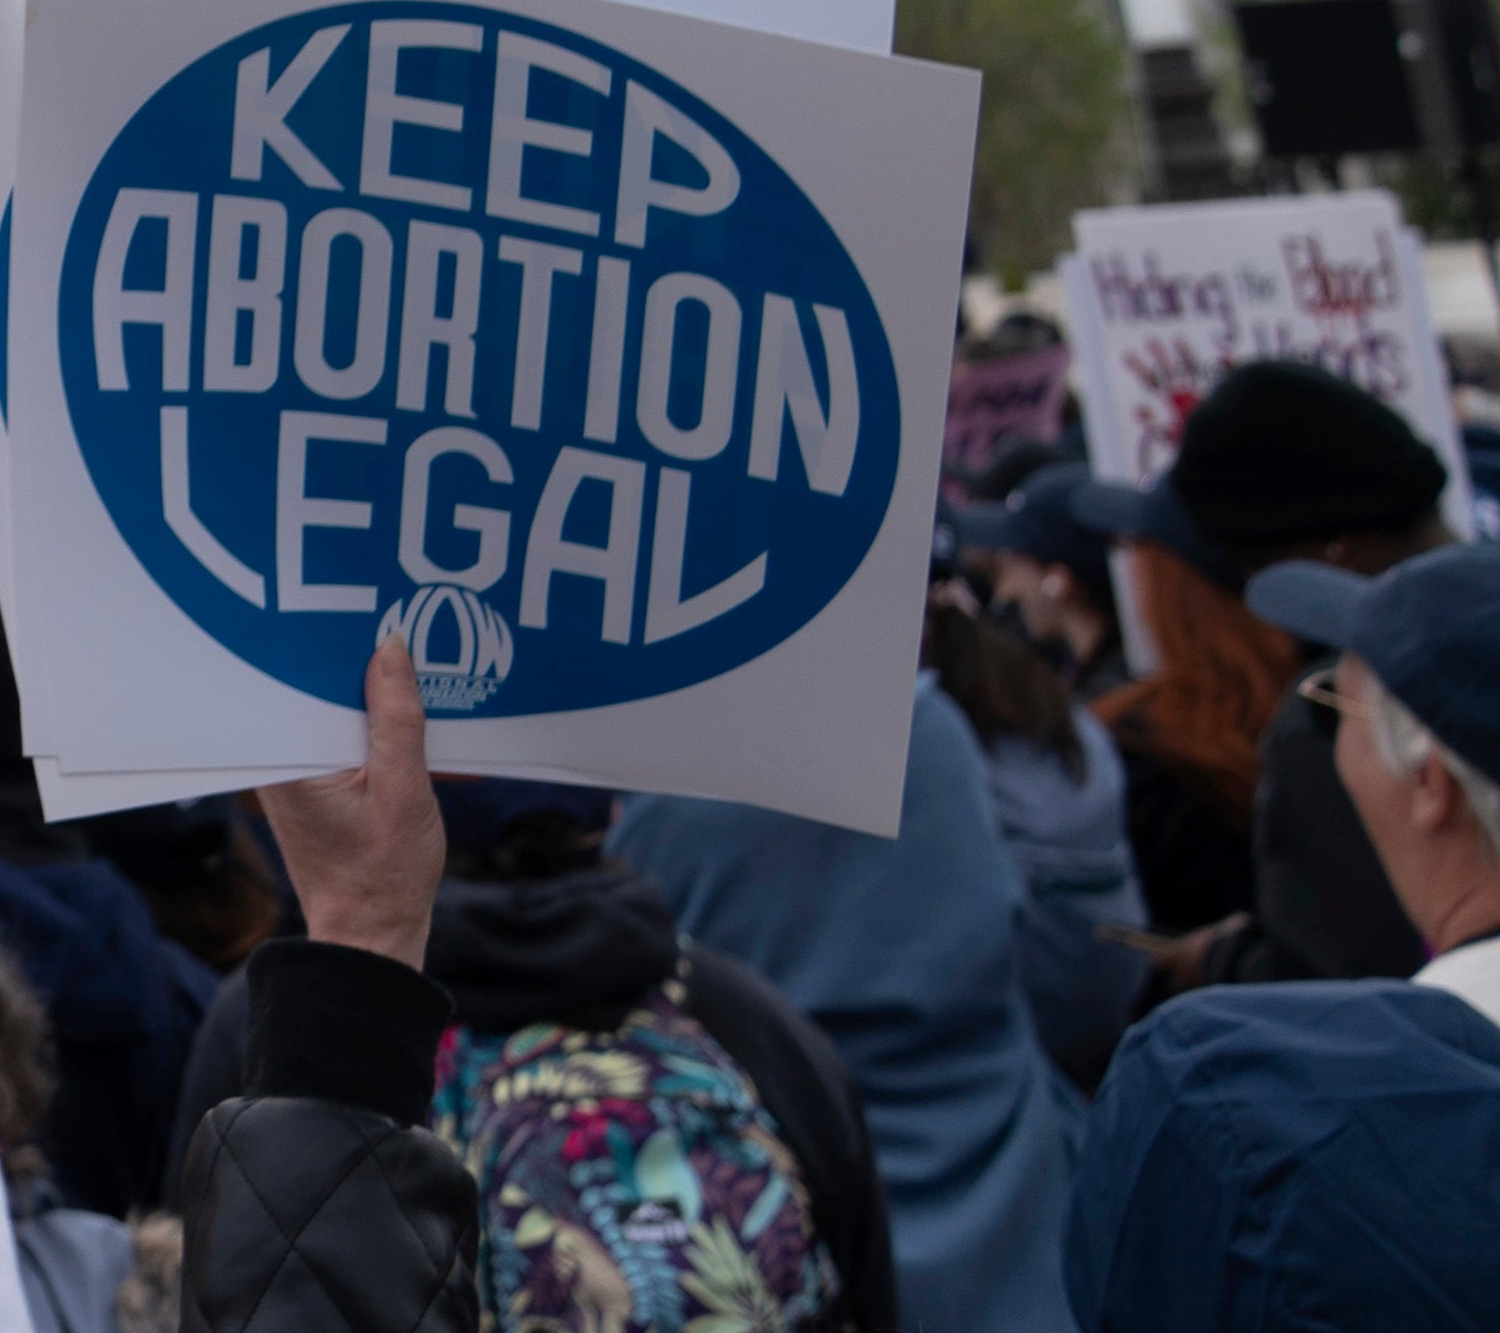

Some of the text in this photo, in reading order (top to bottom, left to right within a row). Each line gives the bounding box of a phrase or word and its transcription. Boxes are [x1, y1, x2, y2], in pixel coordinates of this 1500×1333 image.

[228, 18, 742, 248] KEEP
[92, 187, 862, 498] ABORTION
[159, 404, 769, 647] LEGAL
[375, 585, 514, 685] NOW
